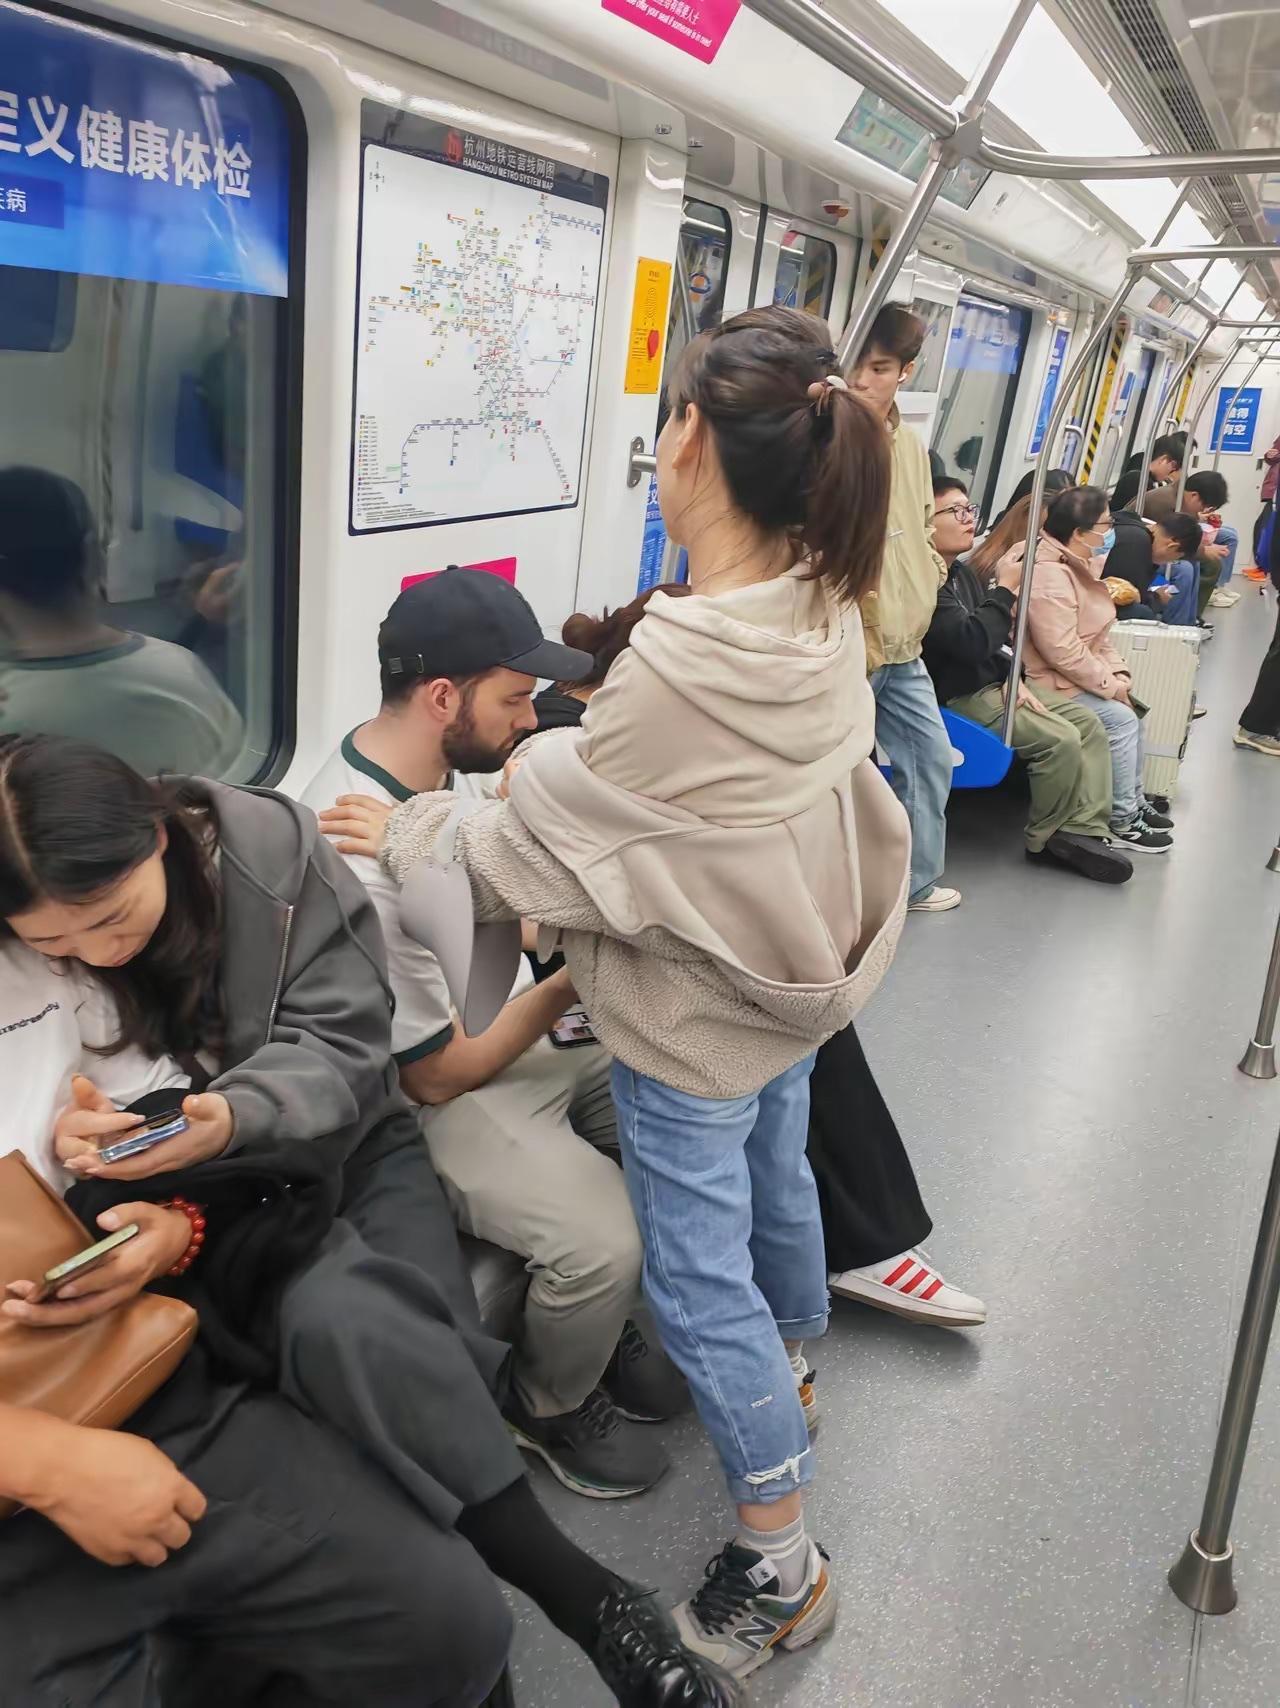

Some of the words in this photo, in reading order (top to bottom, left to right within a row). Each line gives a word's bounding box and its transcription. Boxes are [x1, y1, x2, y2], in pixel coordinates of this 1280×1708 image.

[463, 157, 498, 175] HANGZHOU
[498, 167, 519, 181] METRO
[518, 173, 541, 187] SYSTEM
[541, 179, 554, 191] MAP
[464, 135, 555, 180] 杭州地铁运营线网图
